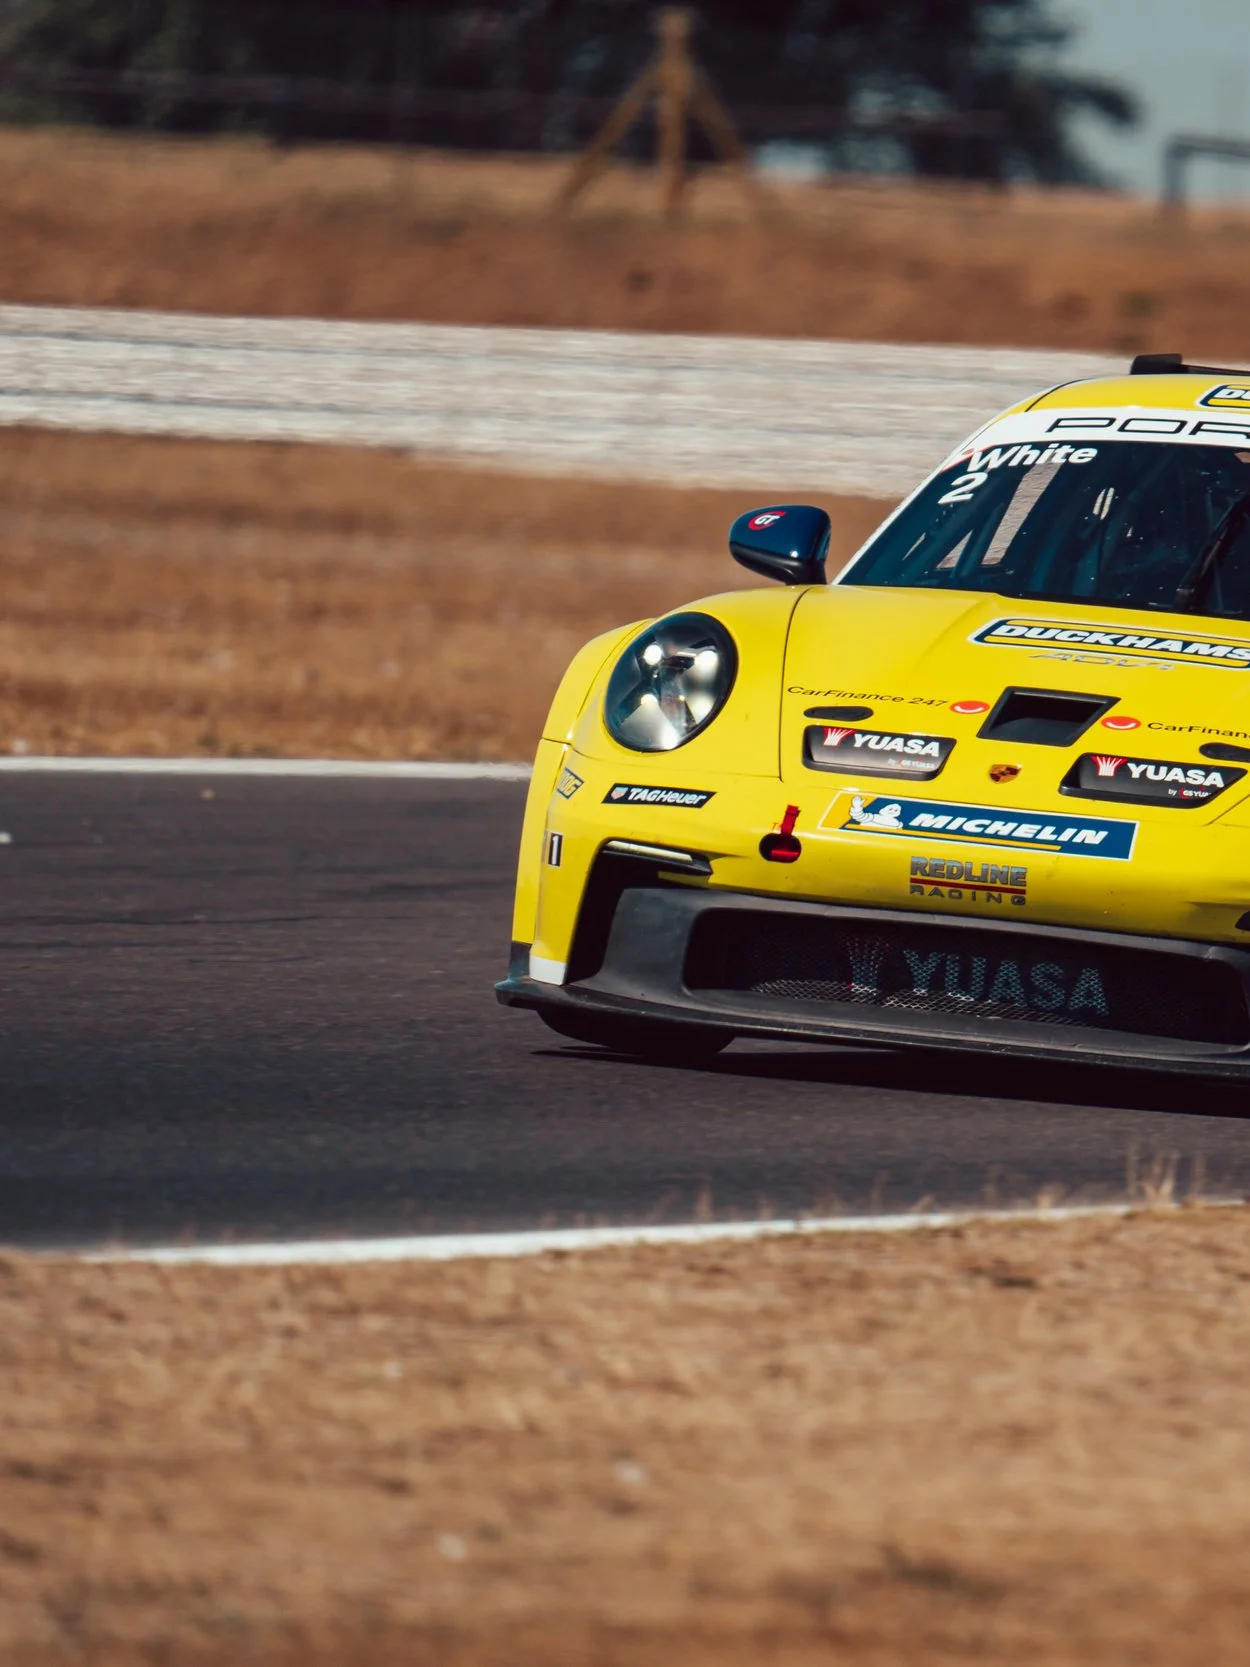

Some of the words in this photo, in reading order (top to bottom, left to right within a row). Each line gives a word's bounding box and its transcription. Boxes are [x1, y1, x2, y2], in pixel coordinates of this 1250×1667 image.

[966, 443, 1098, 472] White
[937, 471, 989, 505] 2
[754, 514, 780, 526] GT
[787, 686, 905, 703] CarFinance
[907, 697, 949, 708] 247
[853, 733, 940, 757] YUASA
[1126, 762, 1225, 788] YUASA
[908, 812, 1109, 845] MICHELIN
[910, 856, 1028, 887] REDLINE
[909, 884, 1027, 907] RACING
[904, 950, 1110, 1017] YUASA
